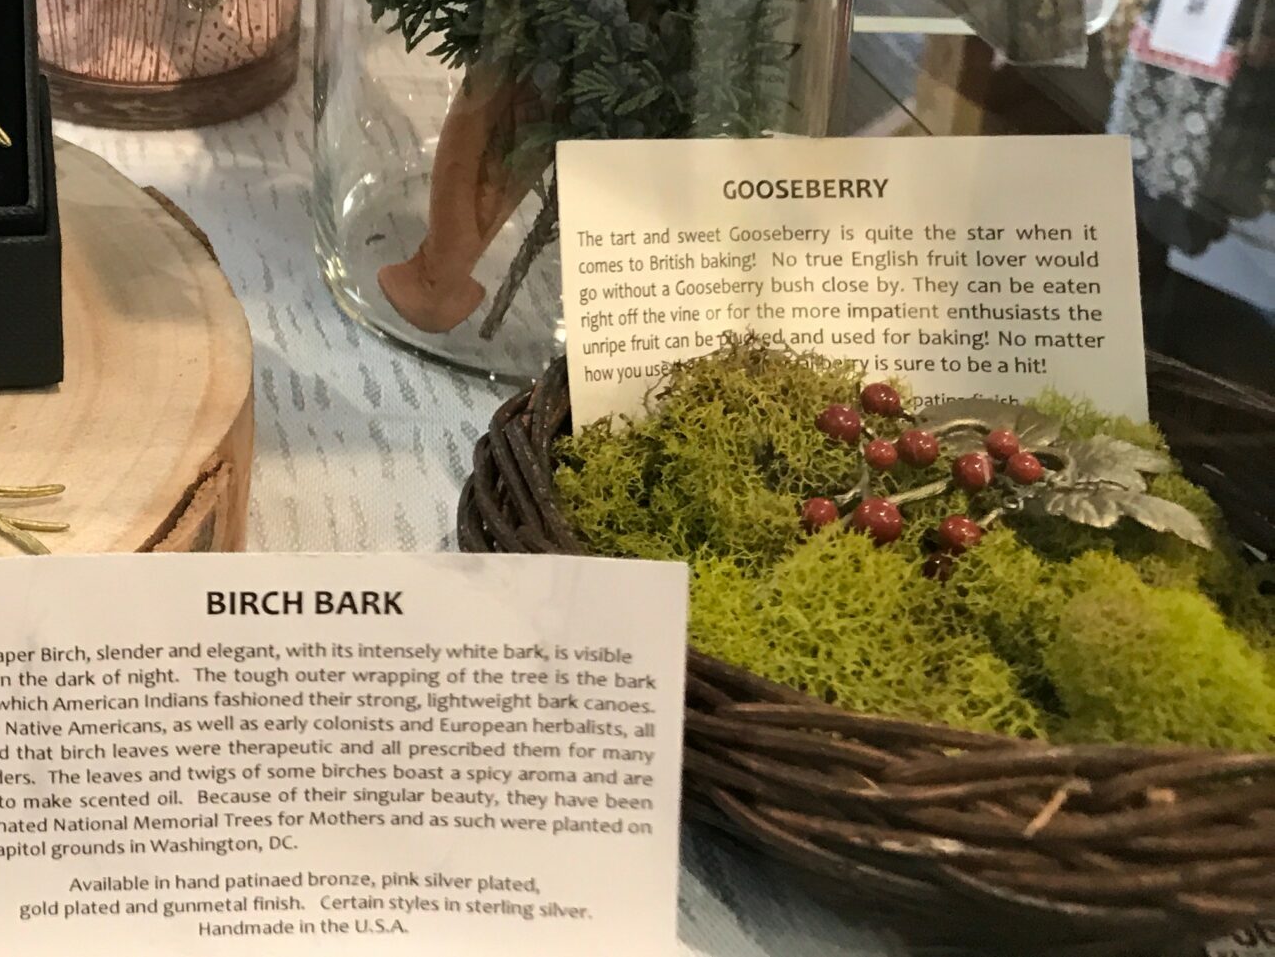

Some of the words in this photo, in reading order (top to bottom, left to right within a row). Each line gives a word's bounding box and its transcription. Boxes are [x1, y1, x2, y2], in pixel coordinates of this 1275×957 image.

[723, 178, 889, 200] GOOSEBERRY
[577, 230, 603, 247] The
[610, 231, 636, 246] tart
[643, 227, 670, 245] and
[678, 228, 721, 244] sweet
[729, 225, 830, 245] Gooseberry
[841, 224, 854, 241] is
[865, 224, 913, 244] quite
[924, 224, 956, 241] the
[967, 226, 1005, 240] star
[1016, 224, 1072, 241] when
[1084, 224, 1097, 241] it
[578, 260, 623, 274] comes
[629, 257, 644, 272] to
[650, 253, 695, 271] British
[701, 252, 756, 272] baking!
[772, 252, 797, 267] No
[805, 252, 843, 267] true
[852, 250, 918, 271] English
[926, 249, 968, 267] fruit
[976, 250, 1027, 267] lover
[1035, 251, 1099, 268] would
[579, 288, 597, 306] go
[602, 282, 657, 299] without
[662, 284, 670, 296] a
[675, 278, 764, 298] Gooseberry
[771, 276, 814, 293] bush
[822, 276, 869, 293] close
[877, 276, 904, 297] by.
[912, 276, 959, 297] They
[967, 281, 1001, 293] can
[1009, 277, 1034, 293] be
[1043, 279, 1101, 294] eaten
[581, 311, 614, 332] right
[618, 308, 638, 326] off
[643, 308, 666, 324] the
[670, 306, 700, 322] vine
[706, 308, 722, 320] or
[727, 303, 751, 319] for
[756, 302, 785, 319] the
[792, 306, 840, 318] more
[847, 303, 939, 322] impatient
[947, 303, 1060, 321] enthusiasts
[1068, 304, 1102, 322] the
[583, 337, 626, 357] unripe
[630, 334, 660, 351] fruit
[665, 336, 689, 349] can
[695, 331, 713, 347] be
[790, 328, 824, 345] and
[831, 328, 875, 344] used
[882, 328, 911, 345] for
[918, 328, 989, 351] baking!
[999, 331, 1026, 347] No
[1035, 332, 1105, 348] matter
[584, 366, 614, 382] how
[617, 366, 642, 384] you
[645, 362, 669, 378] use
[875, 354, 889, 371] is
[894, 359, 935, 372] sure
[940, 357, 961, 372] to
[967, 356, 992, 373] be
[997, 361, 1009, 373] a
[1014, 356, 1047, 374] hit!
[207, 591, 303, 615] BIRCH
[315, 591, 403, 615] BARK
[41, 645, 91, 663] Birch,
[97, 644, 164, 661] slender
[168, 643, 201, 658] and
[207, 642, 280, 663] elegant,
[285, 642, 327, 658] with
[332, 643, 353, 658] its
[358, 643, 442, 663] intensely
[446, 643, 498, 659] white
[503, 643, 550, 662] bark,
[555, 644, 569, 660] is
[574, 646, 633, 664] visible
[53, 695, 139, 711] American
[145, 692, 208, 708] Indians
[214, 691, 303, 707] fashioned
[308, 691, 352, 707] their
[357, 693, 422, 712] strong,
[427, 692, 532, 713] lightweight
[538, 693, 578, 709] bark
[584, 698, 656, 714] canoes.
[48, 769, 80, 784] The
[86, 768, 142, 784] leaves
[149, 766, 181, 782] and
[187, 765, 236, 784] twigs
[242, 763, 261, 779] of
[267, 767, 316, 779] some
[322, 763, 387, 779] birches
[393, 764, 443, 780] boast
[450, 769, 461, 780] a
[467, 766, 512, 784] spicy
[518, 770, 577, 783] aroma
[583, 770, 618, 785] and
[623, 774, 654, 787] are
[51, 839, 125, 860] grounds
[130, 839, 146, 854] in
[150, 837, 263, 856] Washington,
[269, 835, 298, 850] DC.
[69, 875, 149, 892] Available
[155, 875, 170, 889] in
[175, 874, 220, 889] hand
[225, 872, 303, 892] patinaed
[308, 871, 376, 888] bronze,
[382, 871, 419, 890] pink
[424, 872, 473, 889] silver
[477, 875, 540, 895] plated,
[19, 901, 58, 920] gold
[64, 900, 120, 919] plated
[125, 898, 158, 914] and
[163, 897, 247, 918] gunmetal
[253, 896, 305, 911] finish.
[320, 895, 384, 910] Certain
[389, 895, 439, 914] styles
[444, 897, 461, 912] in
[465, 899, 534, 921] sterling
[539, 902, 593, 920] silver.
[199, 920, 294, 936] Handmade
[299, 920, 315, 934] in
[320, 918, 349, 934] the
[355, 919, 408, 933] U.S.A.
